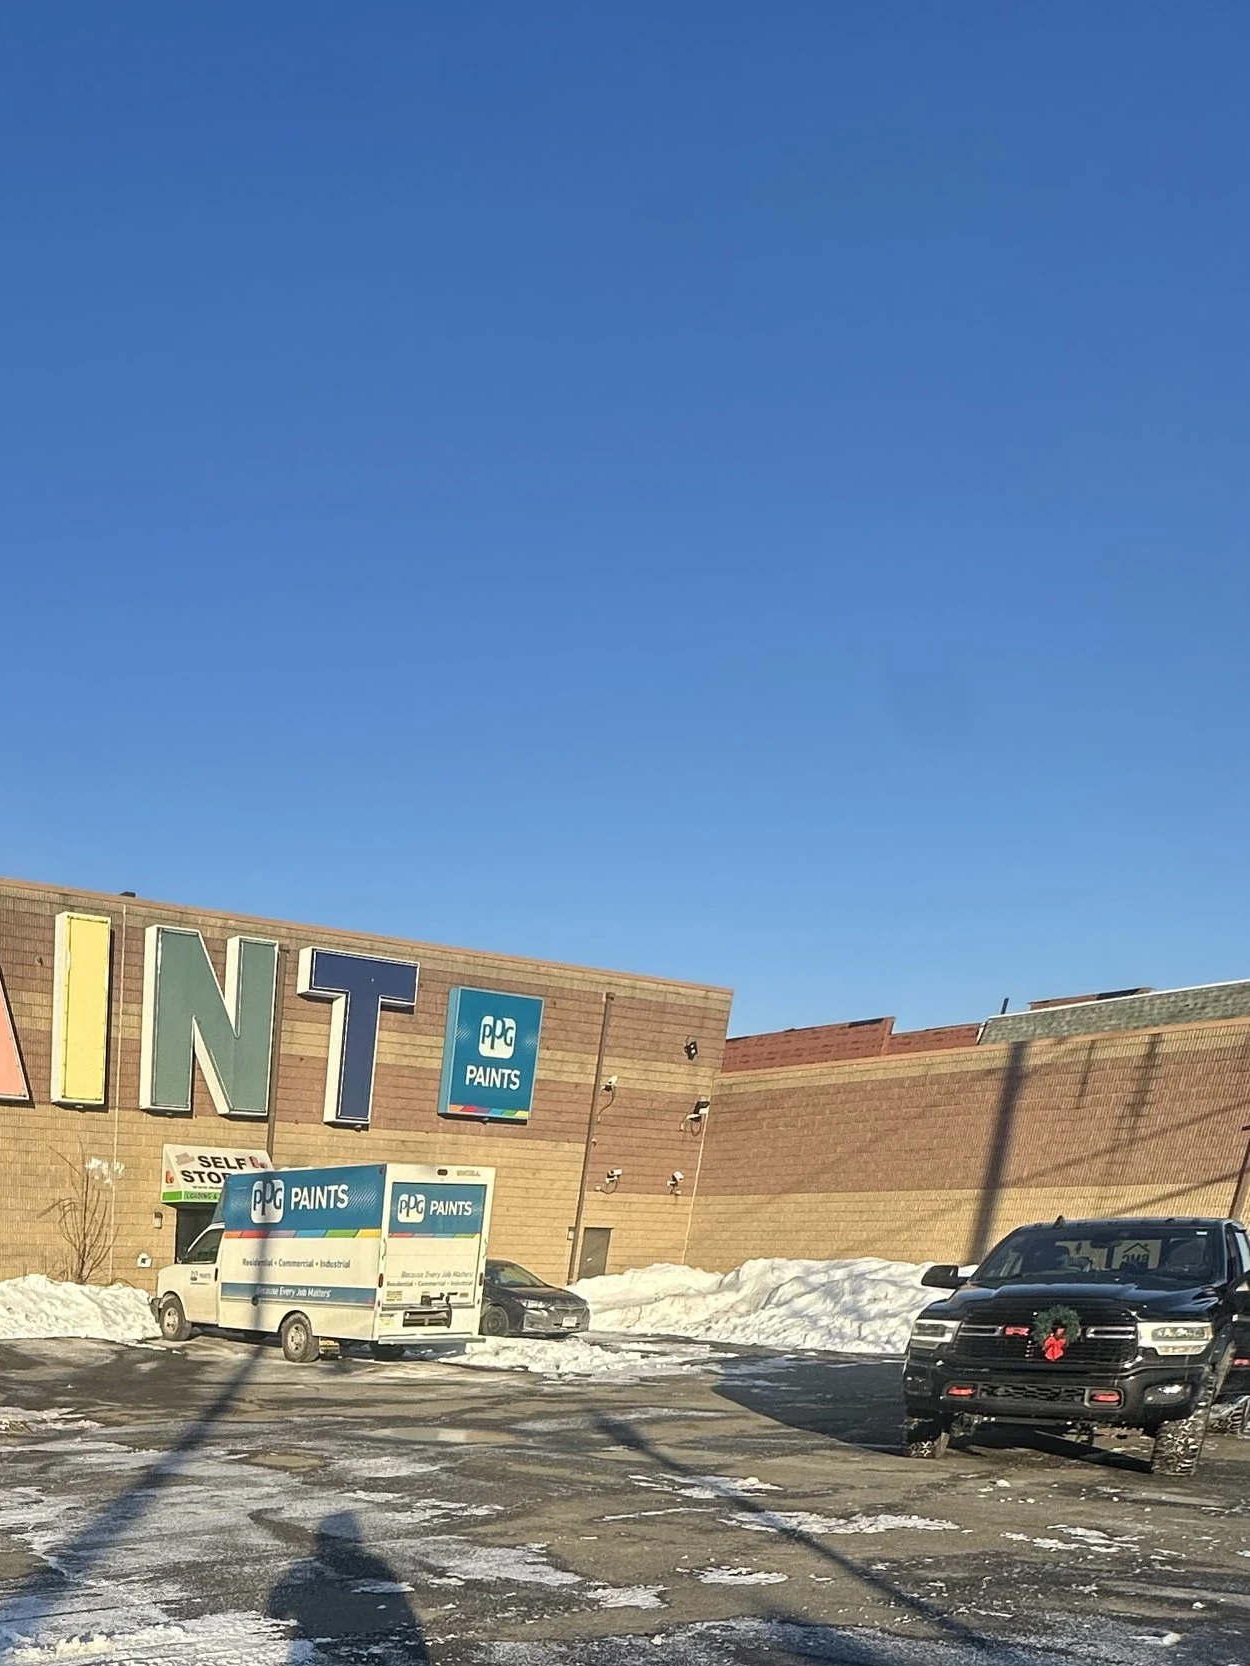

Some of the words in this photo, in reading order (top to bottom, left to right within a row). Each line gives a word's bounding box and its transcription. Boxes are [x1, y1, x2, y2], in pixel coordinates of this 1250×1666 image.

[465, 1065, 520, 1091] PAINTS
[197, 1155, 247, 1170] SELF
[290, 1184, 350, 1211] PAINTS
[429, 1200, 473, 1216] PAINTS
[242, 1258, 273, 1267] Residential
[278, 1259, 314, 1268] Commercial
[320, 1260, 351, 1269] Industrial
[279, 1287, 295, 1298] Every
[296, 1288, 307, 1297] Job
